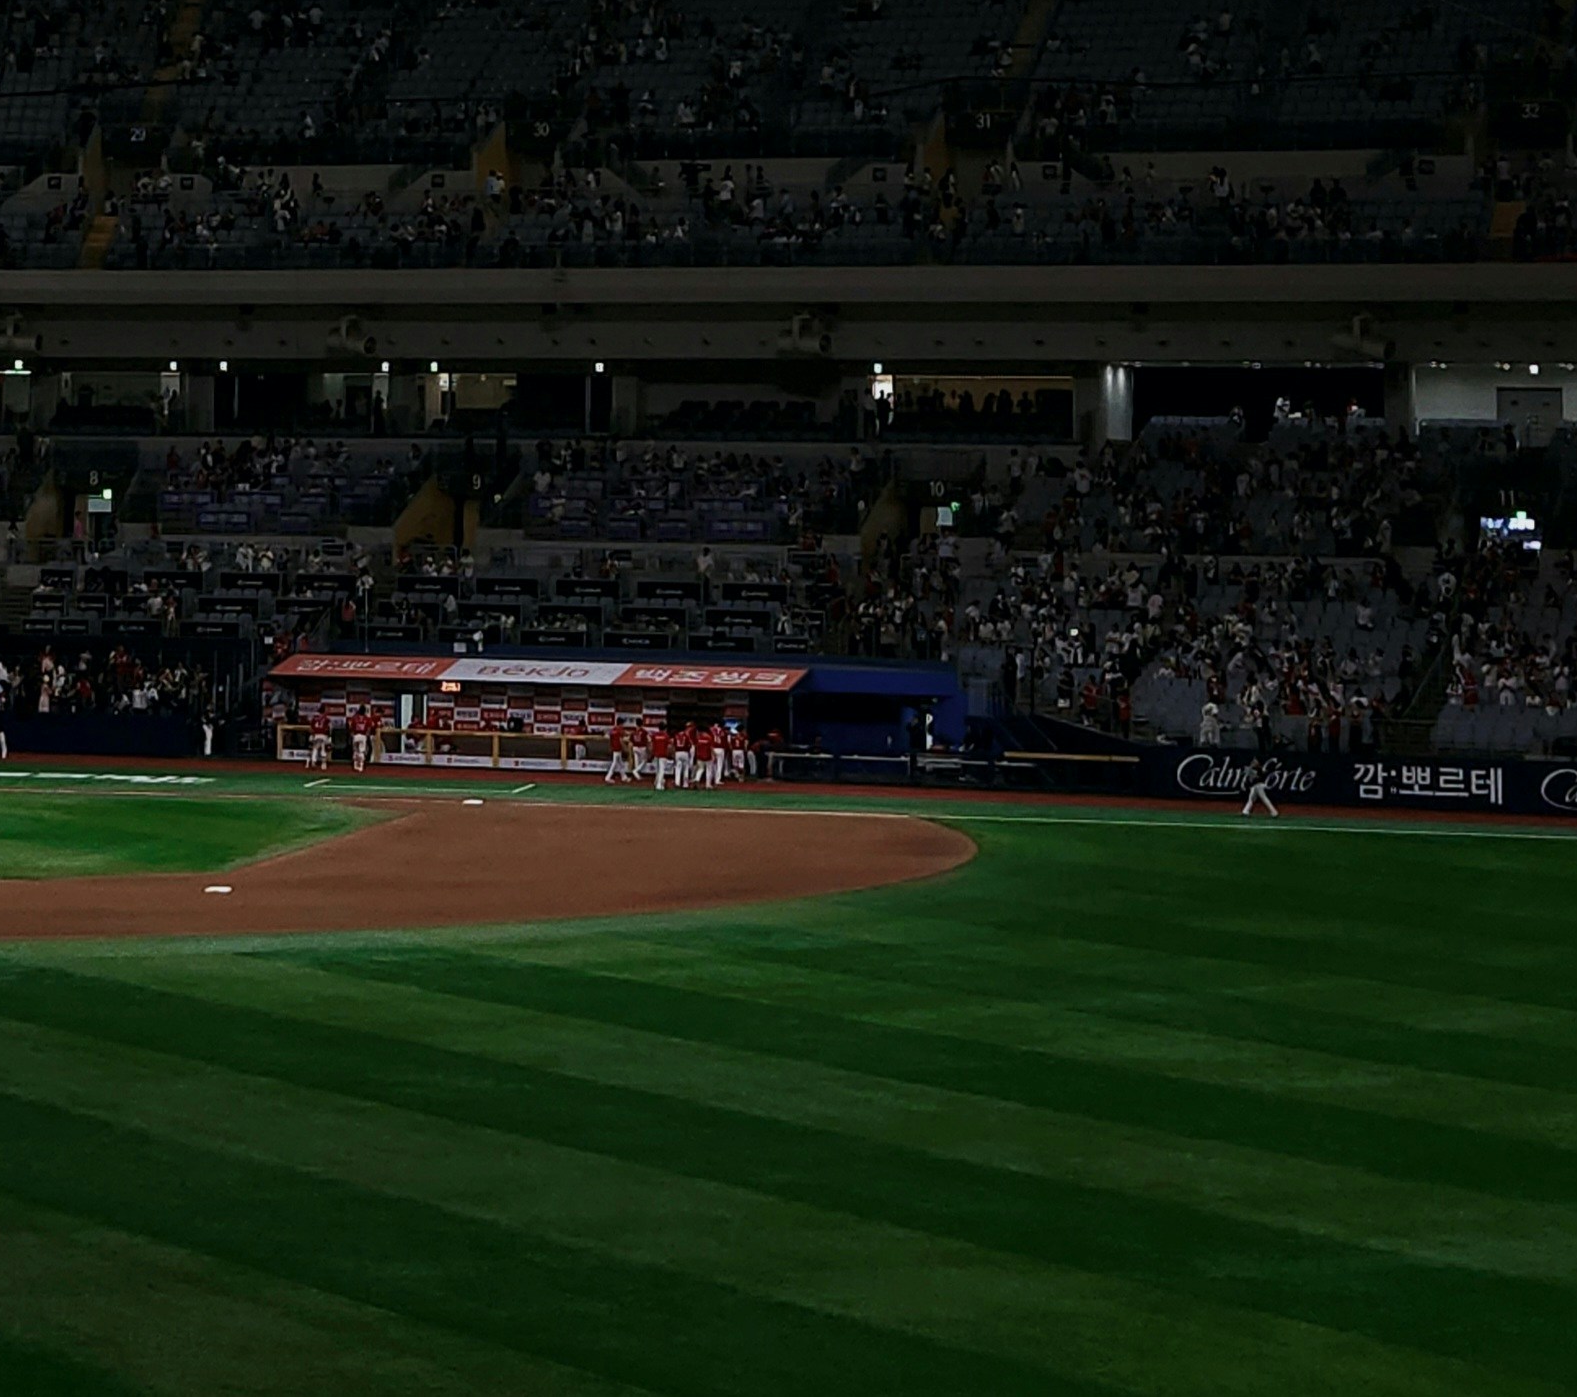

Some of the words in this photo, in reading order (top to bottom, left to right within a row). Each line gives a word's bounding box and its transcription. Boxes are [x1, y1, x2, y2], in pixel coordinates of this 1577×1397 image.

[975, 112, 991, 129] 31
[533, 122, 550, 138] 30
[89, 469, 99, 486] 8
[472, 473, 481, 490] 9
[929, 480, 945, 497] 10
[1498, 489, 1514, 506] 11
